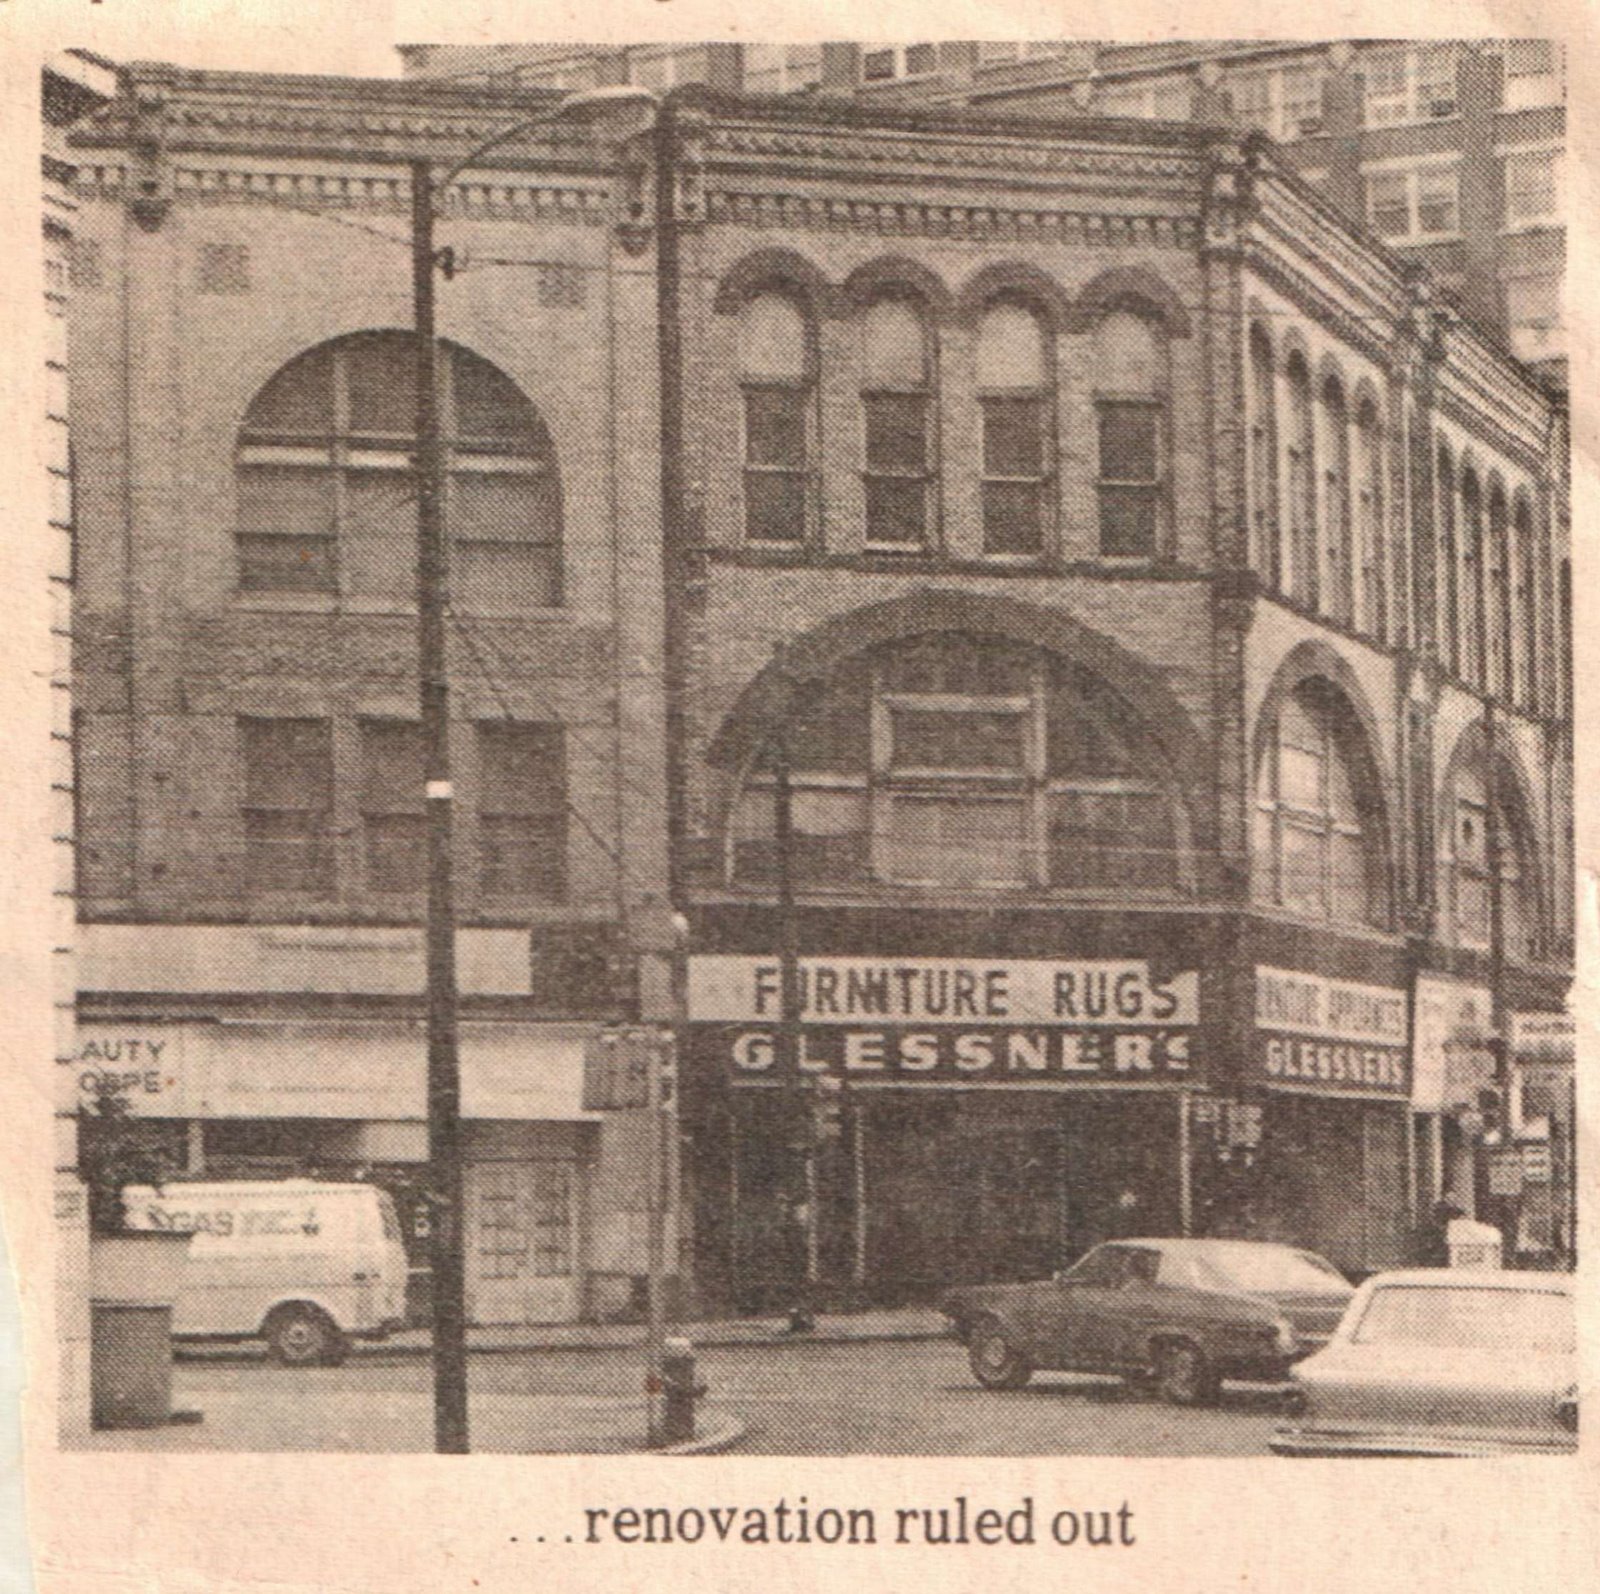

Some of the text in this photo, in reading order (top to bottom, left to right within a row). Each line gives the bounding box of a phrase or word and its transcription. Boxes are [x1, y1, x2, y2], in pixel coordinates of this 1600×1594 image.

[1053, 971, 1179, 1019] RUGS
[731, 1031, 1190, 1072] GLESSNER'S
[893, 1496, 1037, 1545] ruled
[1050, 1500, 1138, 1546] out
